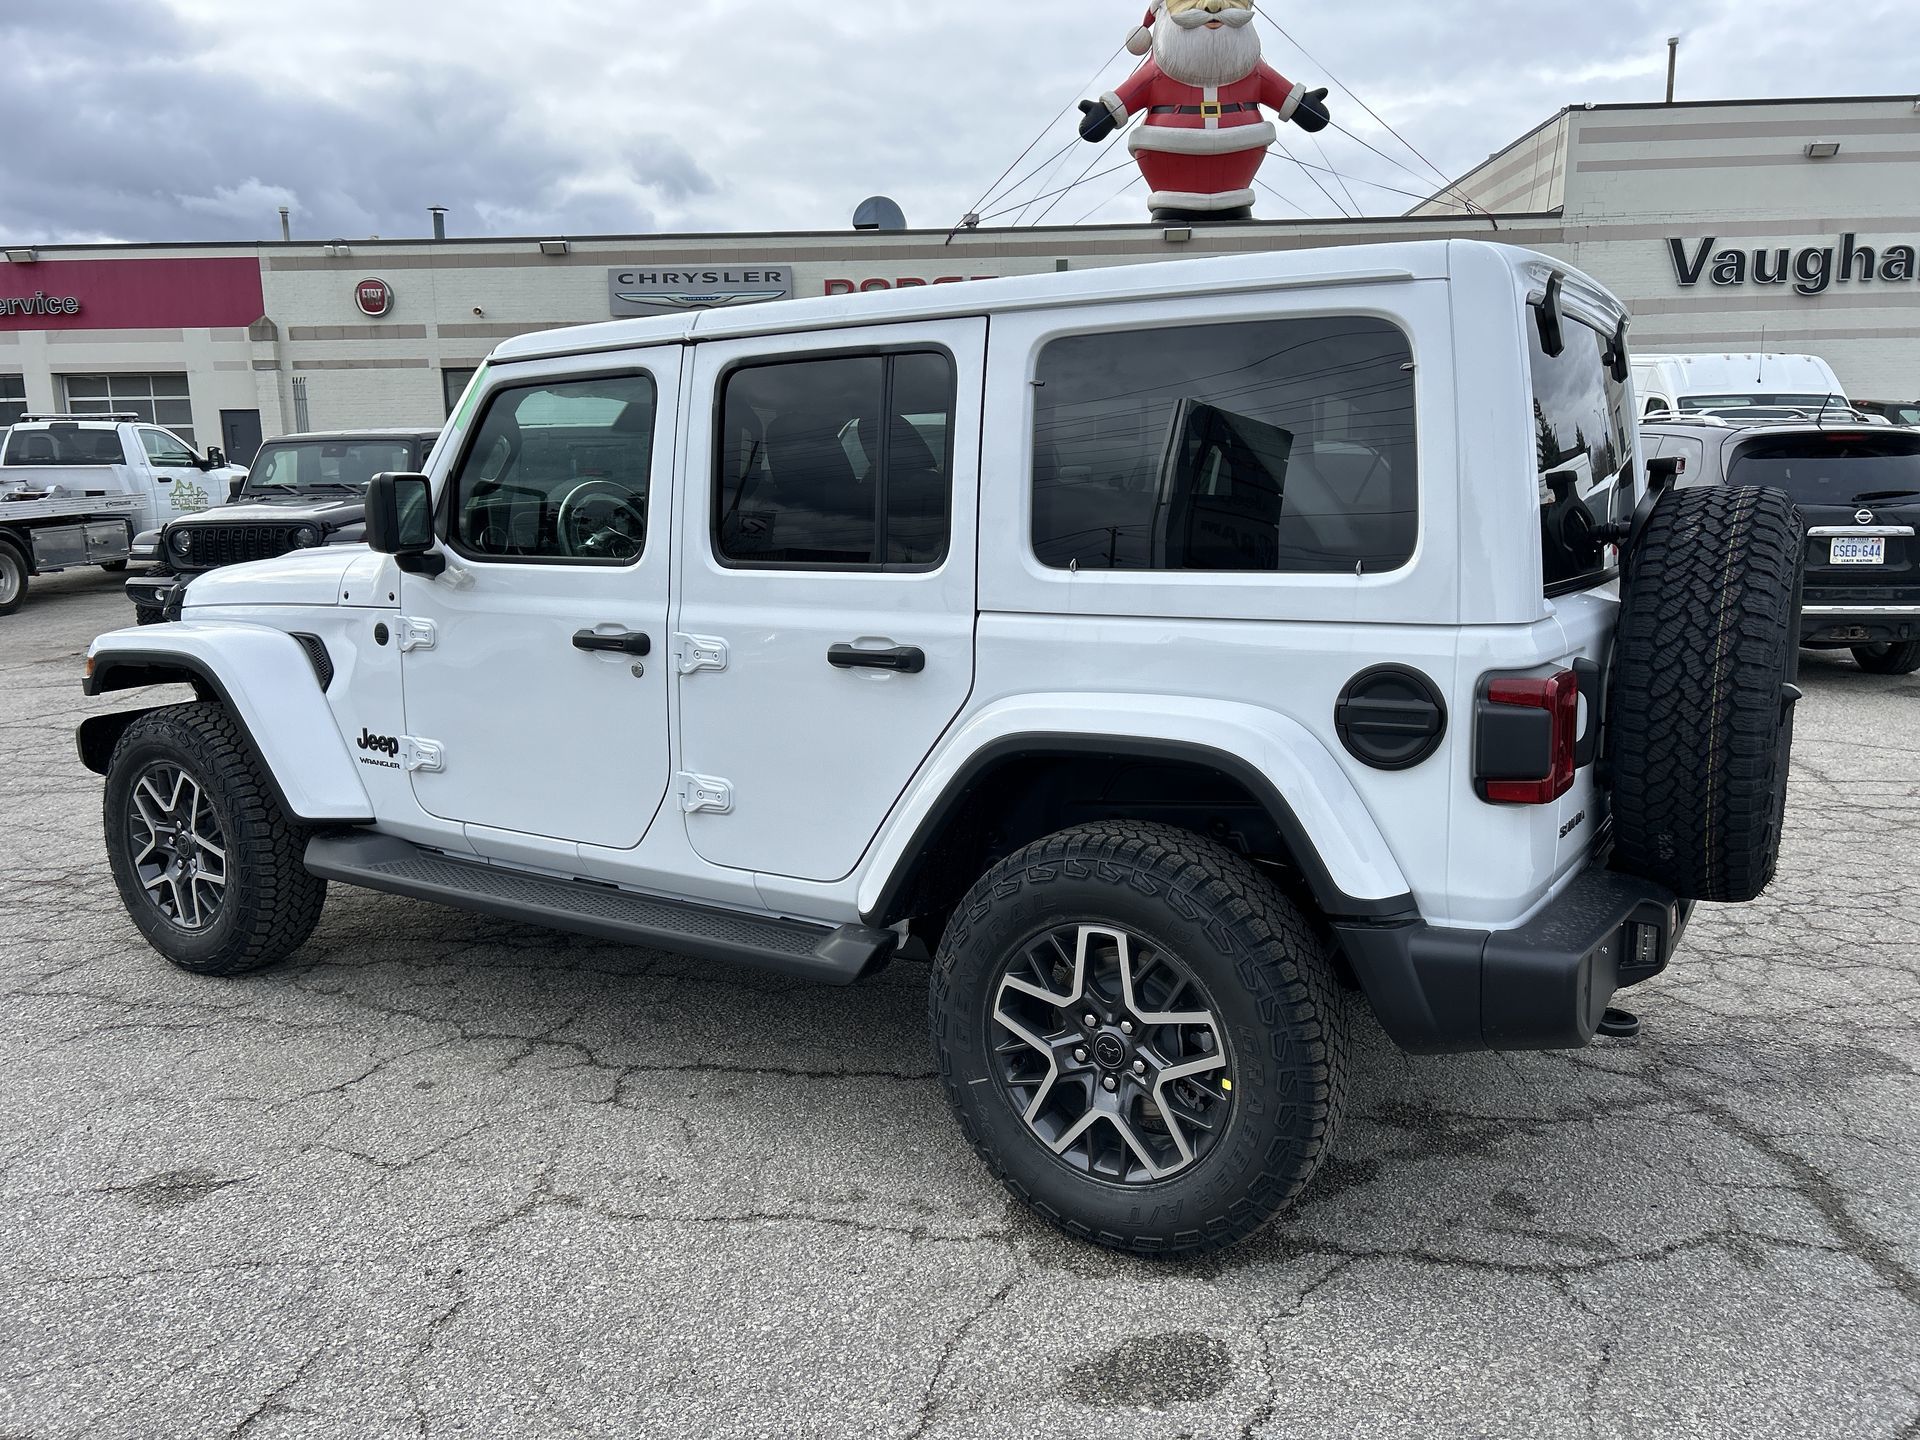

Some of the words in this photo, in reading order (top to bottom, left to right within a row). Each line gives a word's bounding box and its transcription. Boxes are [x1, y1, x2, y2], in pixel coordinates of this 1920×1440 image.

[1666, 232, 1920, 295] Vaugha
[617, 271, 782, 285] CHRYSLER
[361, 288, 383, 305] FIAT
[357, 728, 399, 758] Jeep
[359, 756, 400, 769] WRANGLER
[953, 892, 1056, 1053] GENERAL
